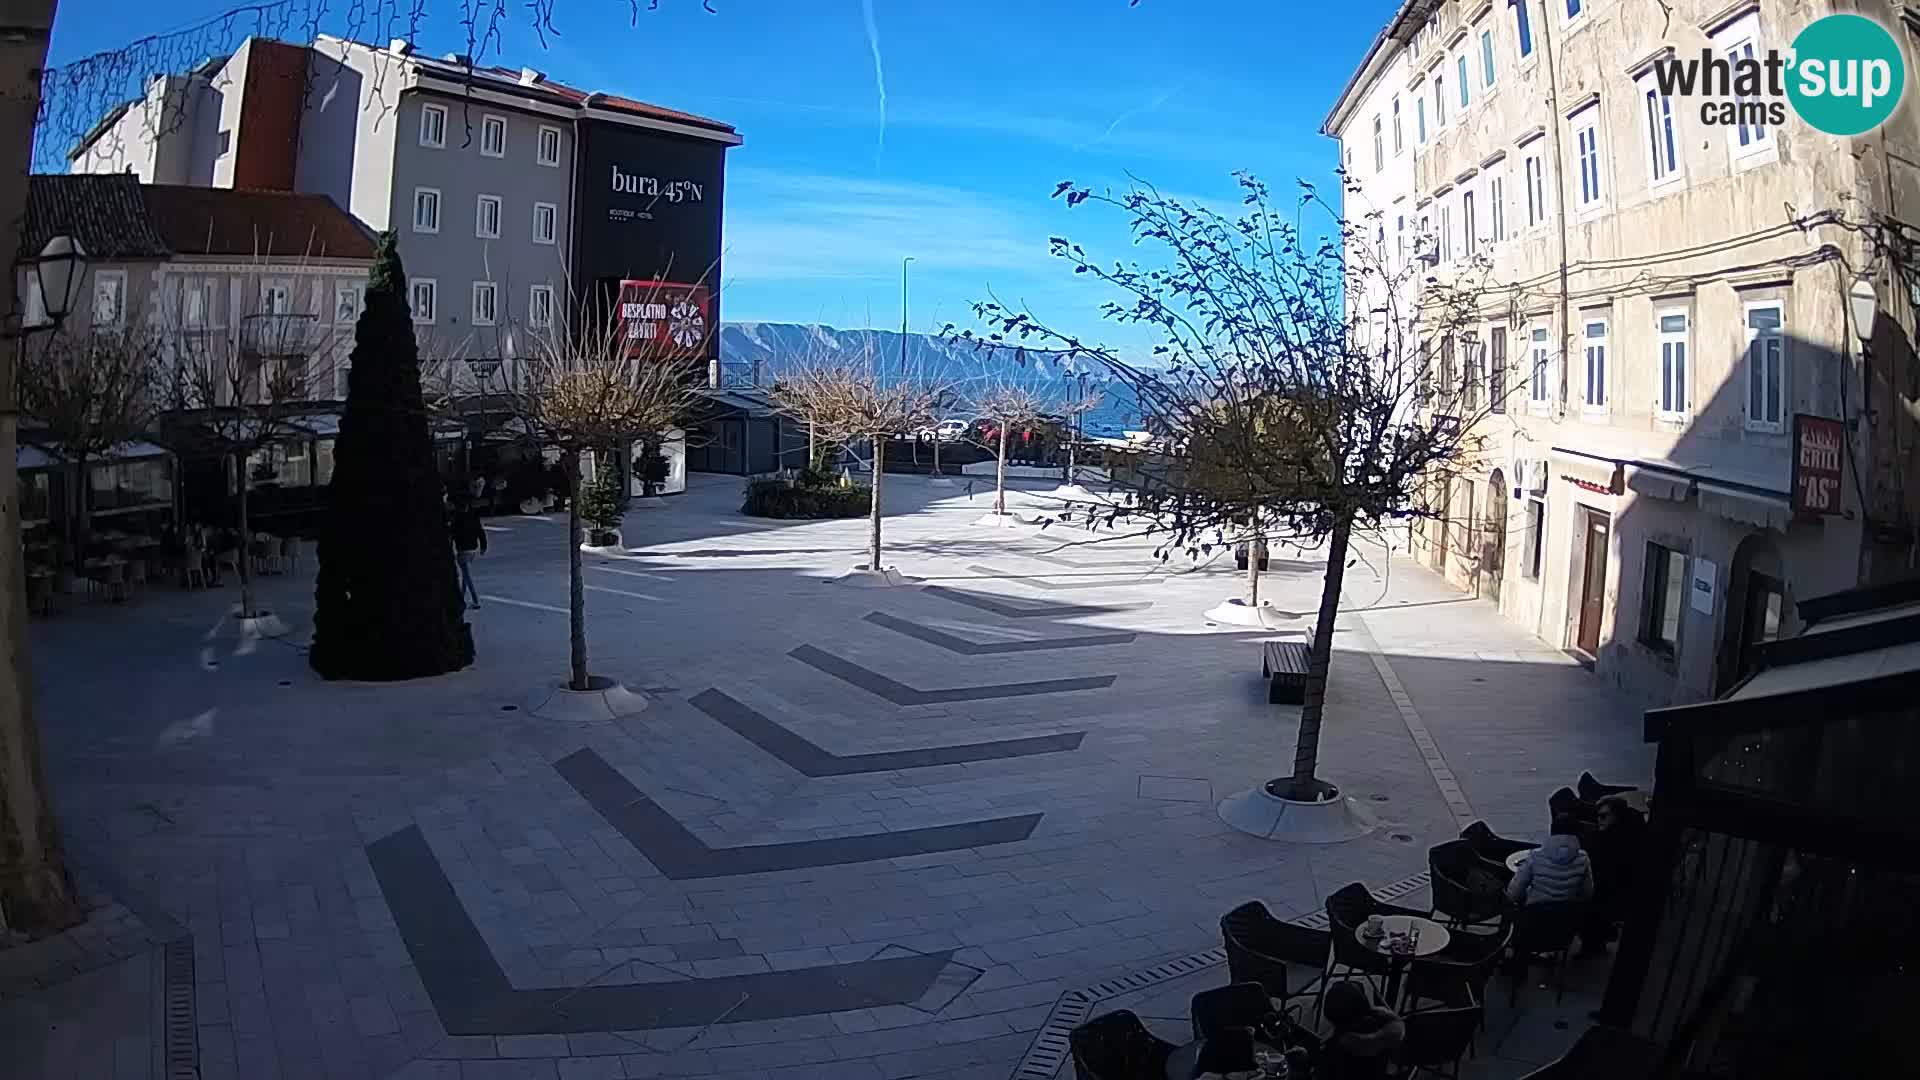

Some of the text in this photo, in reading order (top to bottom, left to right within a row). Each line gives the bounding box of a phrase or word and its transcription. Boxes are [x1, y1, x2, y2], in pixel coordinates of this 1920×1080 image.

[612, 165, 658, 196] bura
[622, 303, 667, 319] BESPLATNO
[1800, 448, 1840, 471] GRILL
